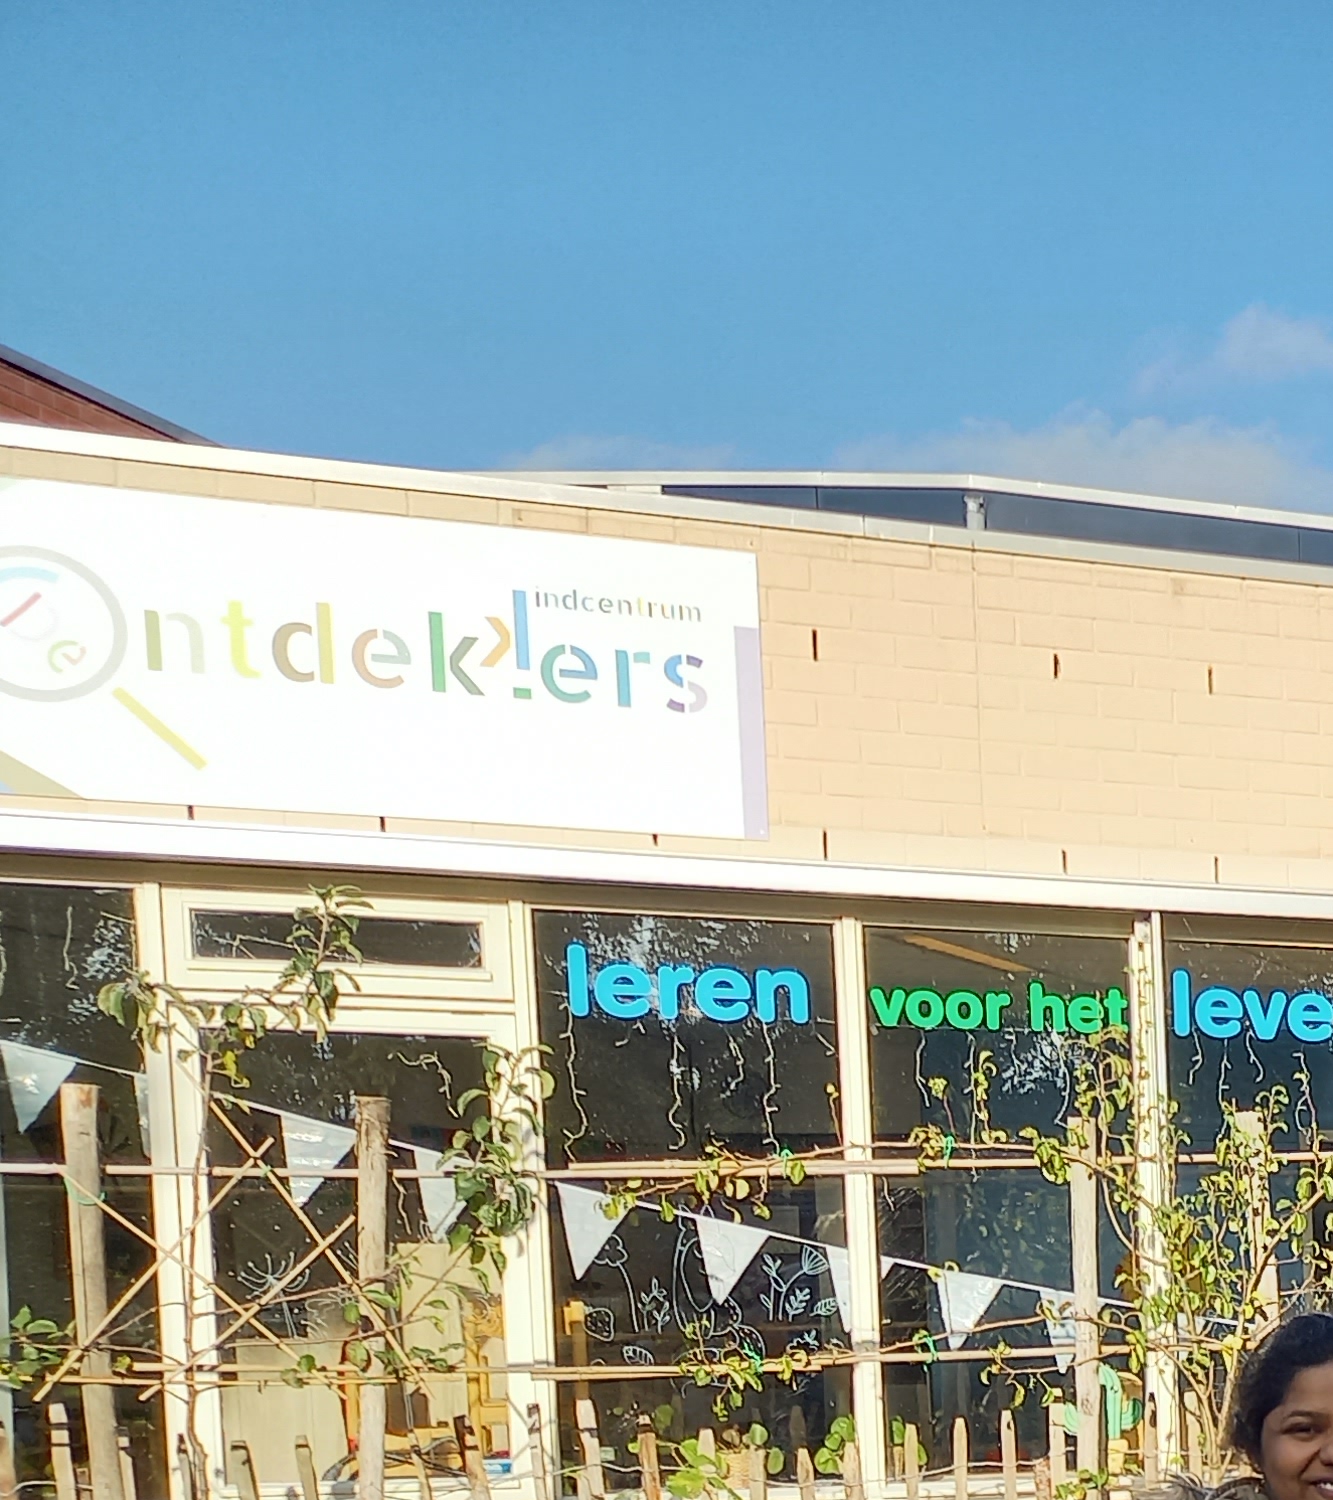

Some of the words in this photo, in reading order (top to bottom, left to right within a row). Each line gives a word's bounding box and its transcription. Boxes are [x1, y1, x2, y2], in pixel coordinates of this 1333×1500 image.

[566, 942, 811, 1024] leren
[868, 984, 1011, 1032] voor
[1028, 979, 1129, 1034] het
